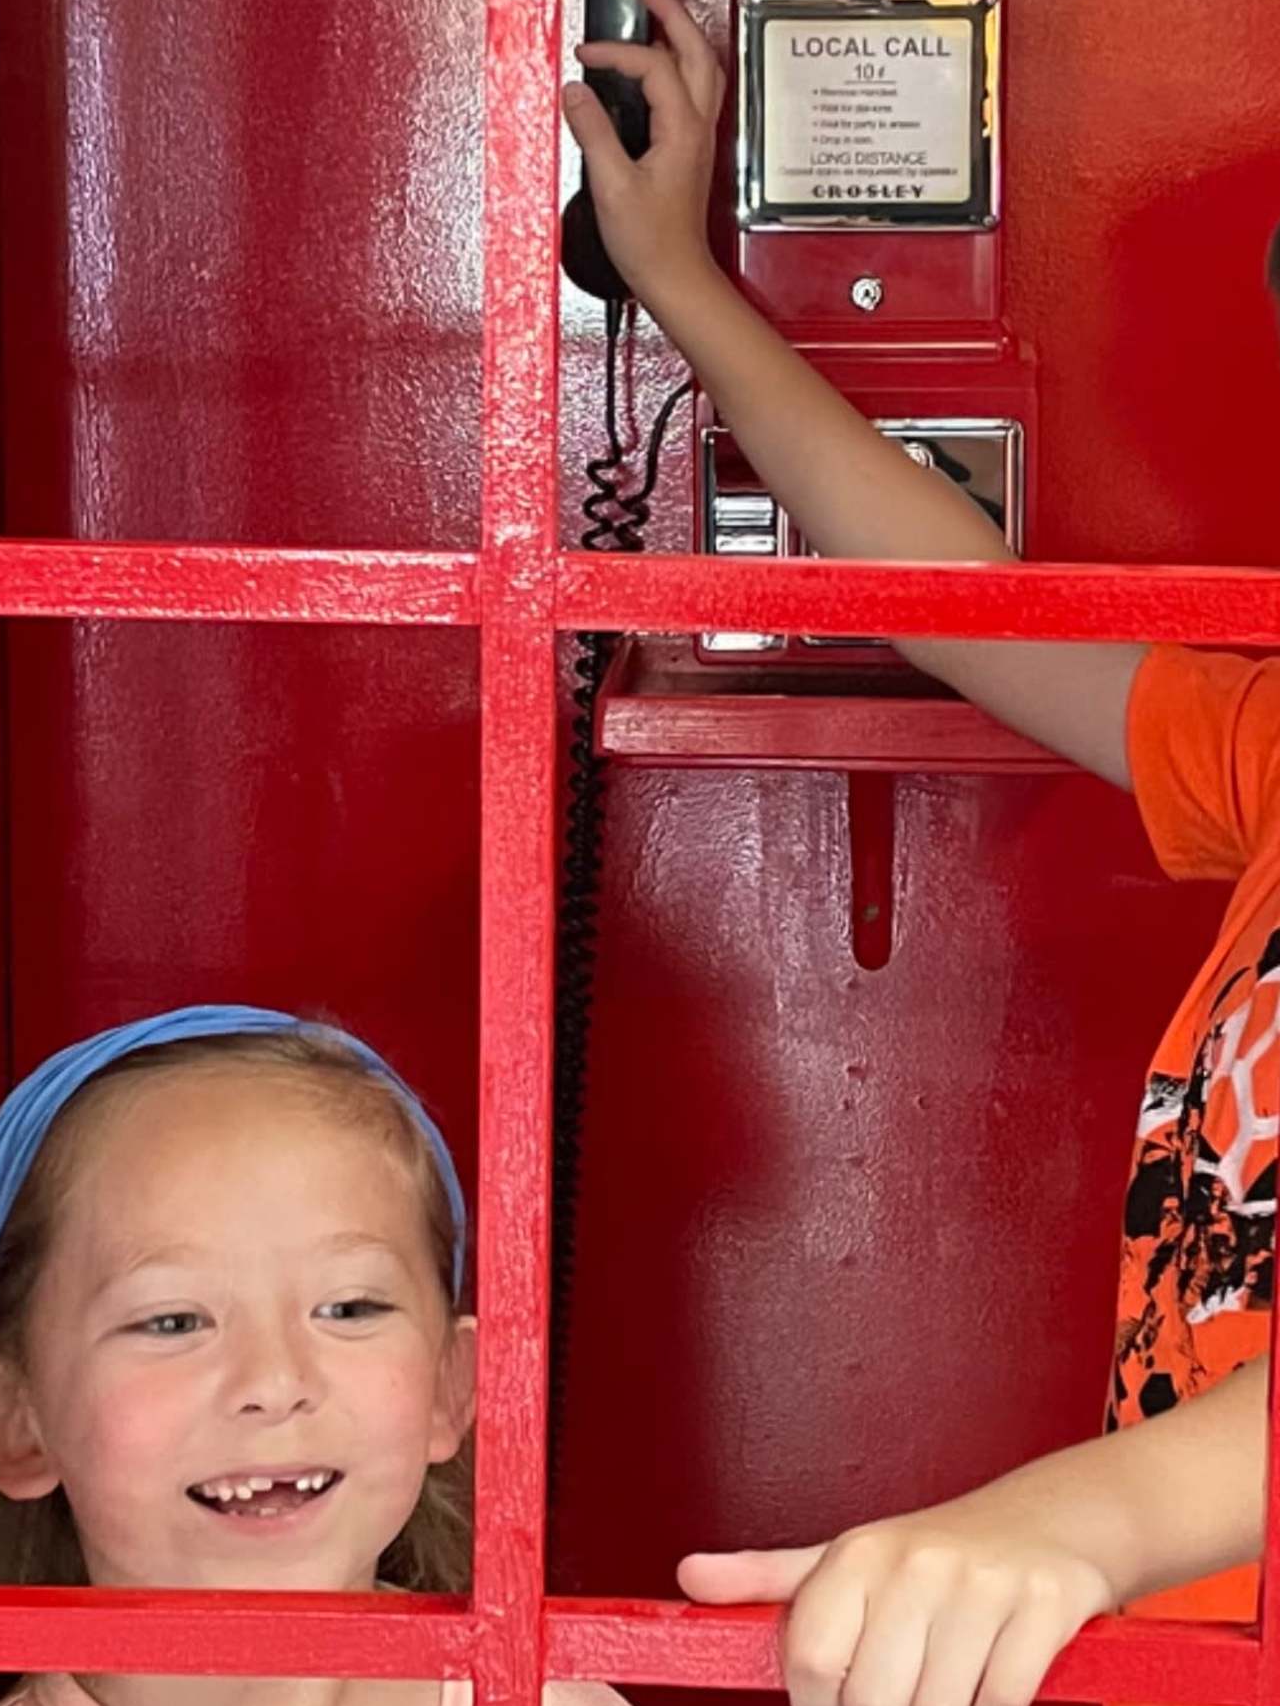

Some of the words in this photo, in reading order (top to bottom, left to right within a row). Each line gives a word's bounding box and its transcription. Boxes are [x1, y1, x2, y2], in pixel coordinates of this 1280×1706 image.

[791, 36, 876, 57] LOCAL
[885, 36, 952, 57] CALL
[810, 151, 851, 166] LONG
[855, 151, 928, 166] DISTANCE
[812, 184, 925, 199] CROSLEY
